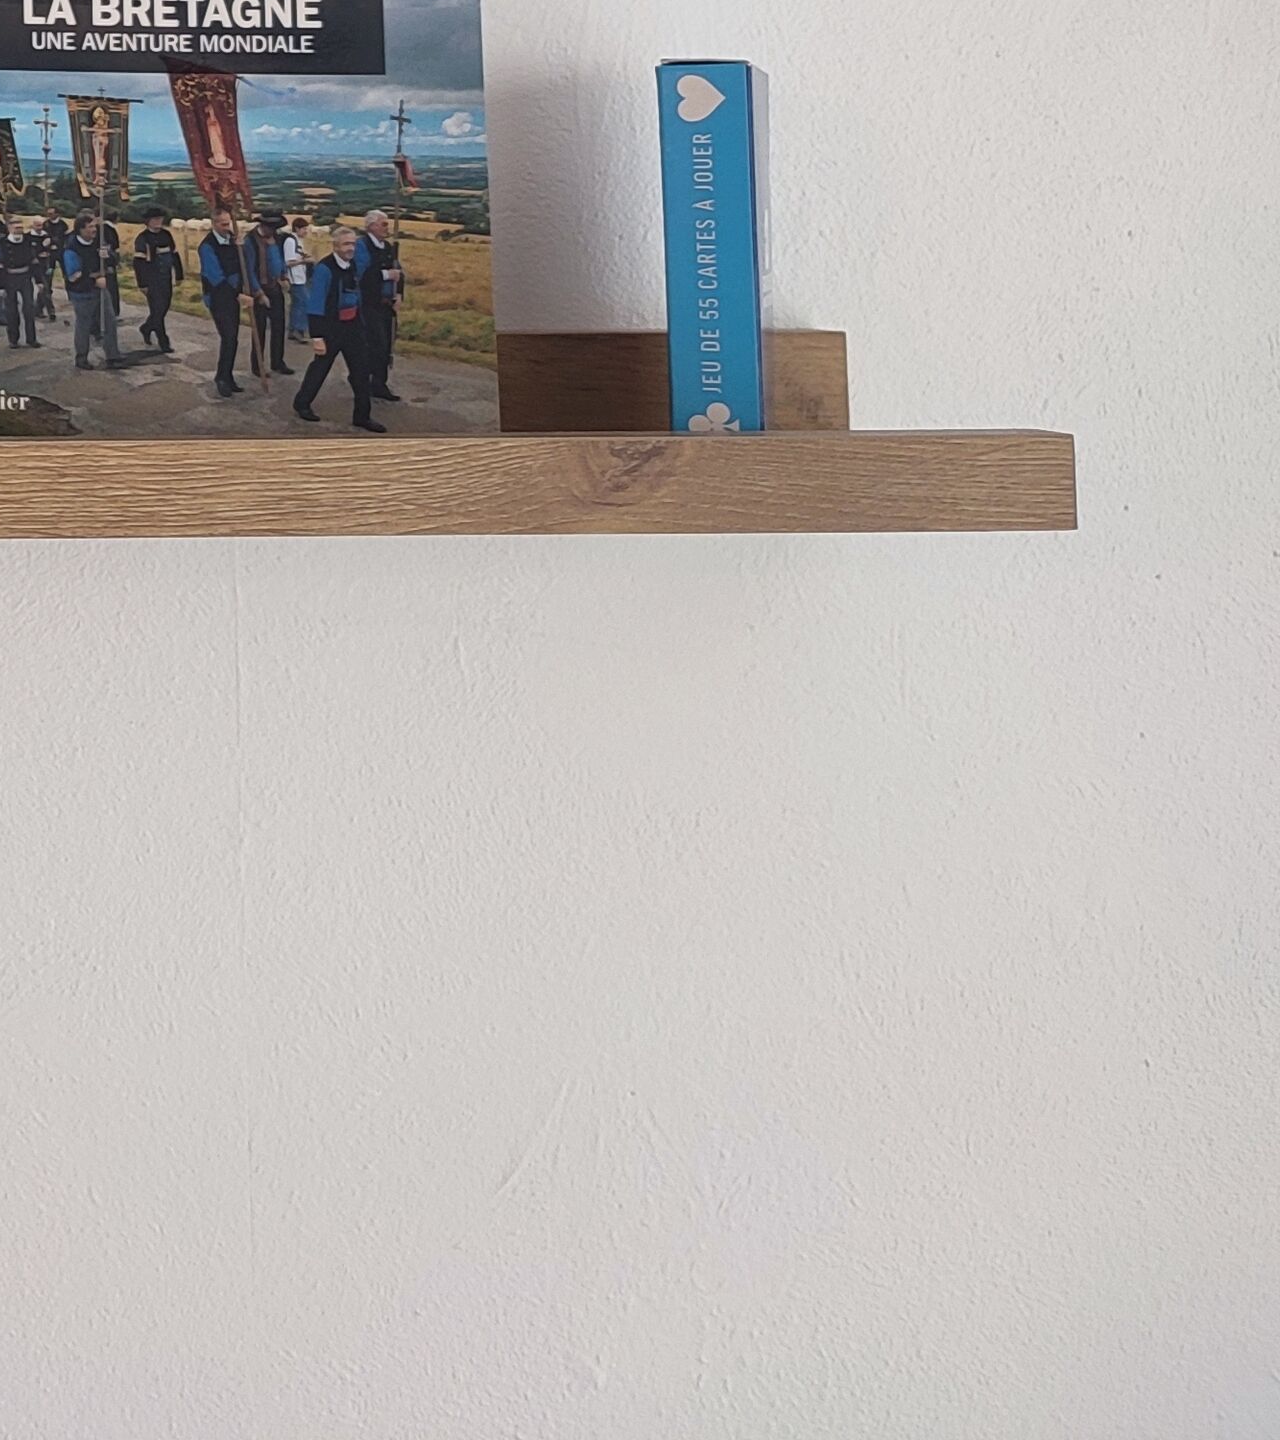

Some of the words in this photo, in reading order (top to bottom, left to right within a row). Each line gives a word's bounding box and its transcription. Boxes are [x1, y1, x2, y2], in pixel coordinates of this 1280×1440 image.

[31, 31, 76, 50] UNE
[81, 32, 192, 53] AVENTURE
[199, 34, 315, 54] MONDIALE
[693, 133, 714, 190] JOUER
[696, 219, 717, 289] CARTES
[698, 298, 719, 319] 55
[700, 329, 720, 351] DE
[702, 361, 722, 393] JEU
